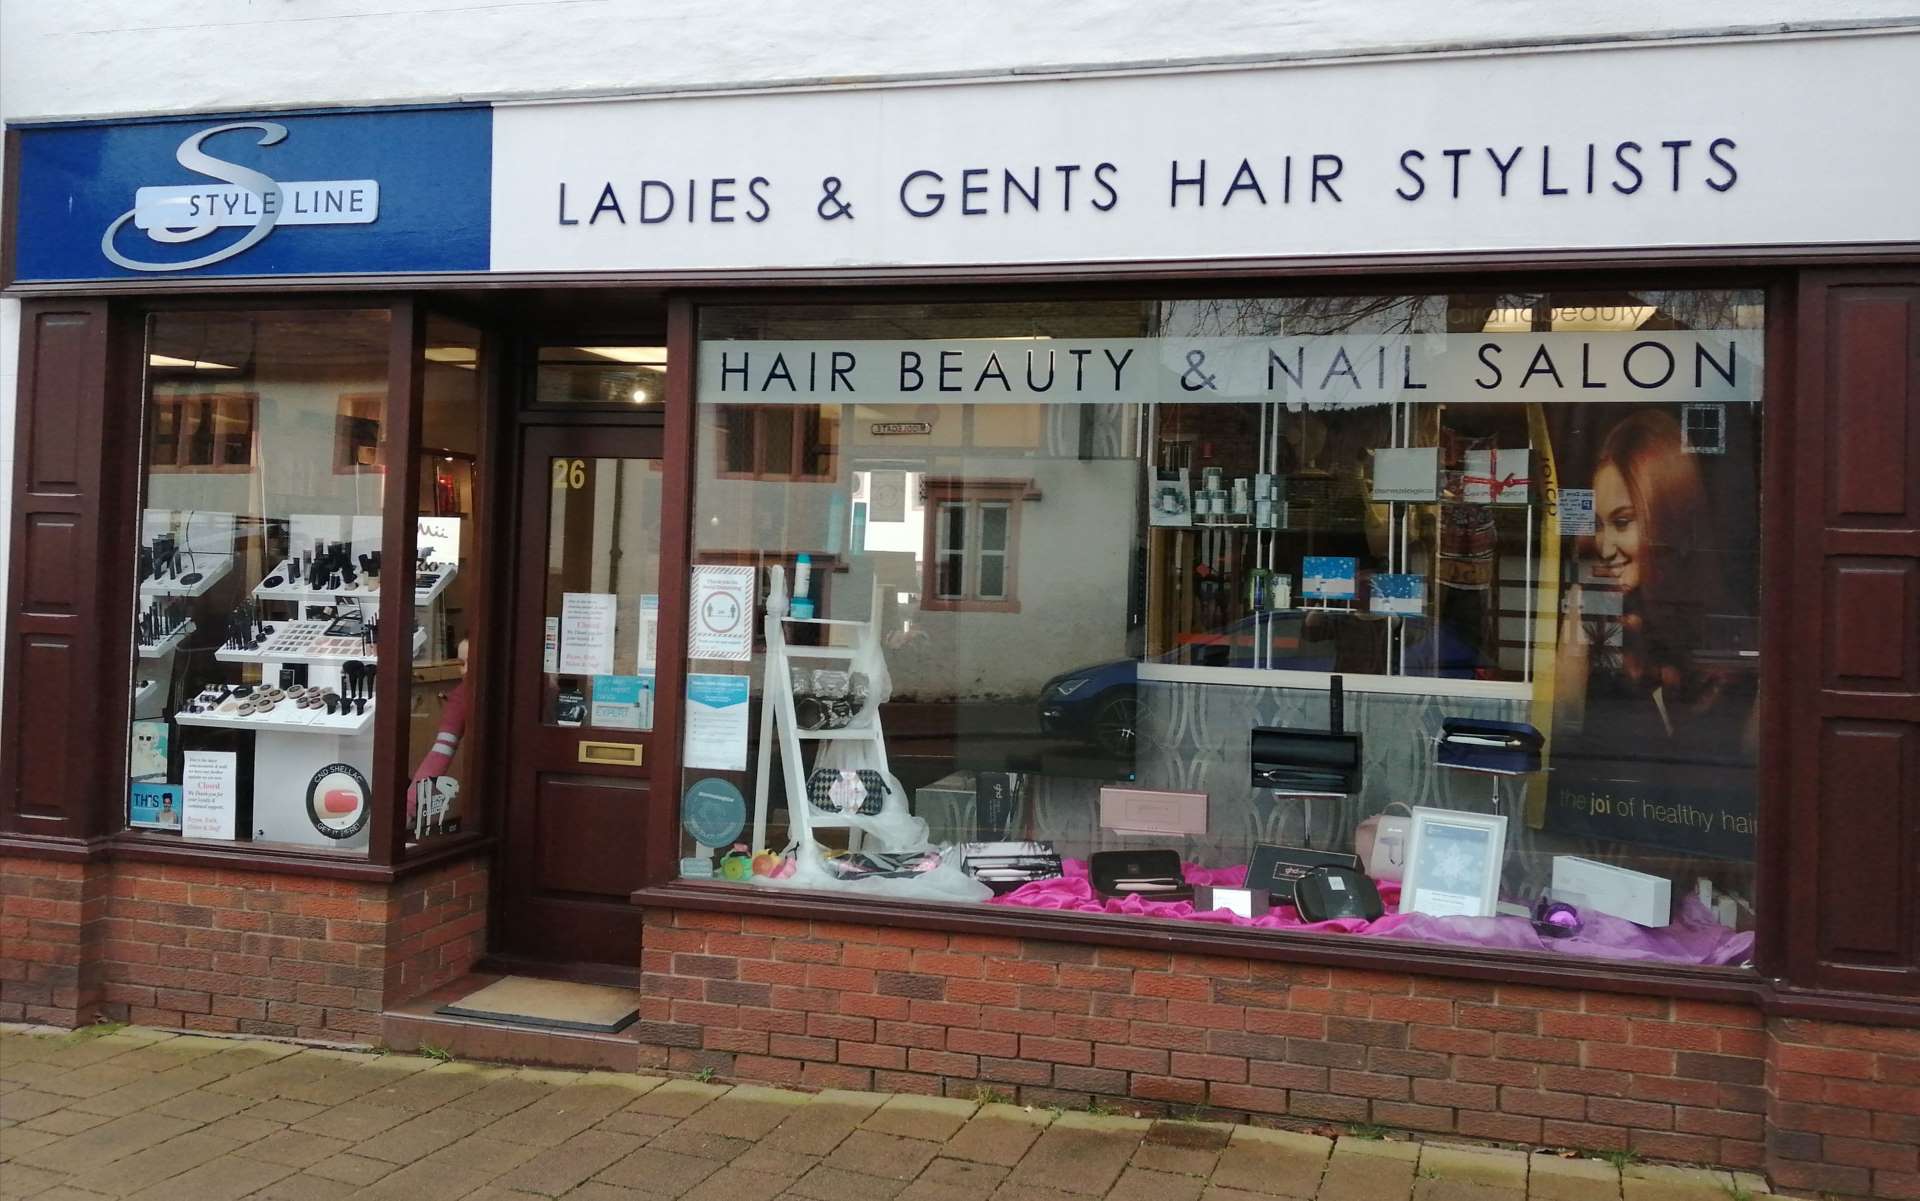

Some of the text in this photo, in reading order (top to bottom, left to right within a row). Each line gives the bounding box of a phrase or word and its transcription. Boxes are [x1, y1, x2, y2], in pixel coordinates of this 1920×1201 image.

[559, 137, 1738, 226] LADIES & GENTS HAIR STYLISTS
[189, 189, 364, 217] STYLE LINE
[721, 341, 1736, 393] HAIR BEAUTY & NAIL SALON
[553, 459, 585, 489] 26
[329, 765, 363, 782] SHELLAC
[1589, 792, 1611, 816] joi
[1616, 797, 1636, 817] of
[1642, 798, 1714, 833] healthy
